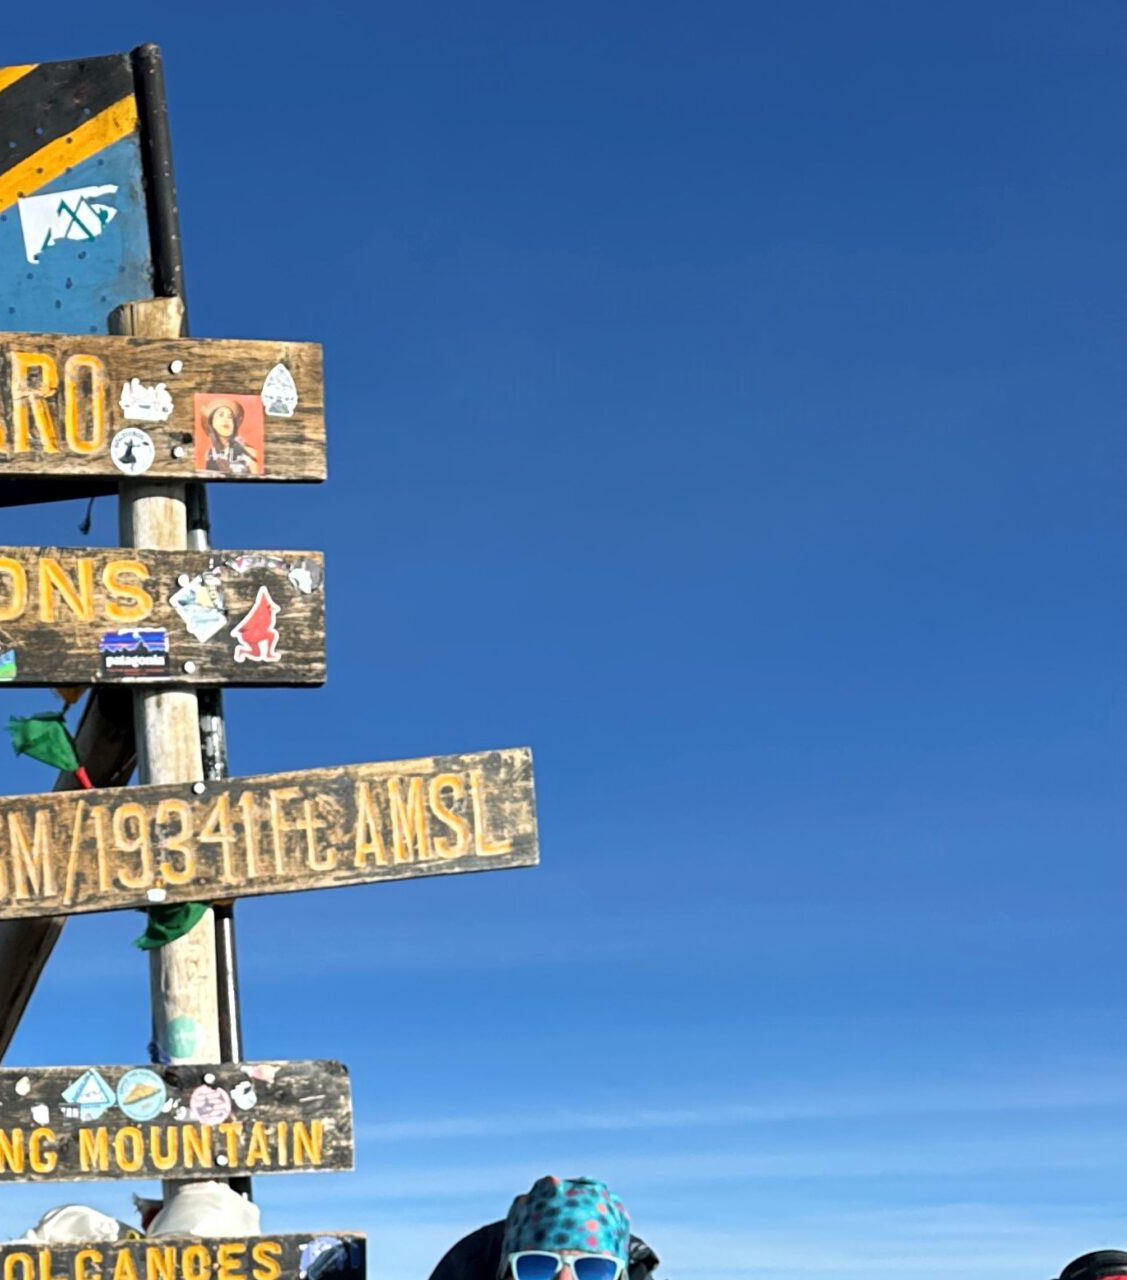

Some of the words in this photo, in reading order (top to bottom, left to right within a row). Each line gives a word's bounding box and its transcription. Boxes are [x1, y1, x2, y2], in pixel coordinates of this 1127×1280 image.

[105, 655, 166, 668] patagonia
[354, 771, 512, 868] AMSL
[78, 1119, 323, 1173] MOUNTAIN
